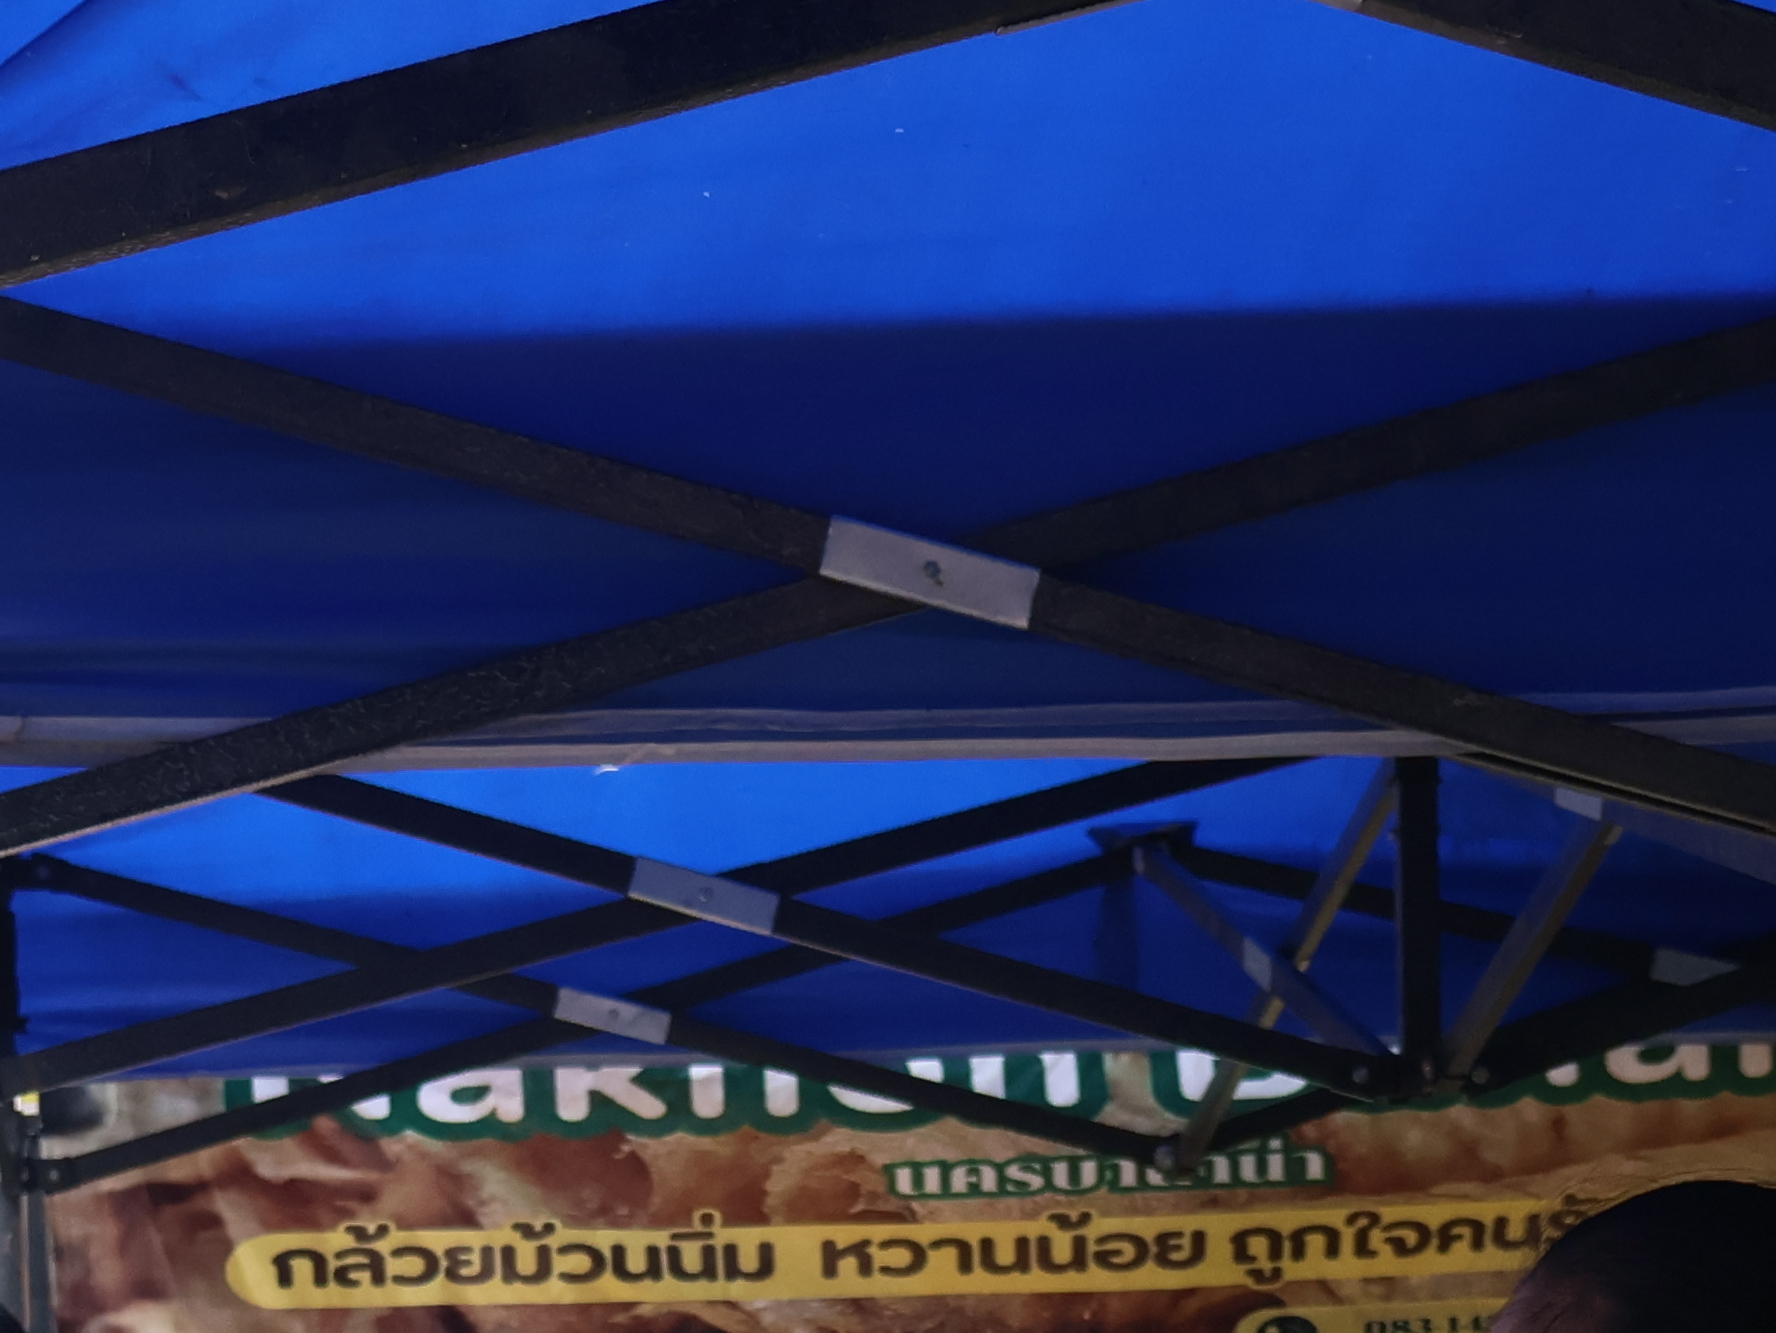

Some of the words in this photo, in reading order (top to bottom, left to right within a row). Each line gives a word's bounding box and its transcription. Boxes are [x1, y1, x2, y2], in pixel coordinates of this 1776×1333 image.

[272, 1211, 775, 1289] กล้วยม้วนนิ่ม
[821, 1211, 1206, 1279] หวานน้อย
